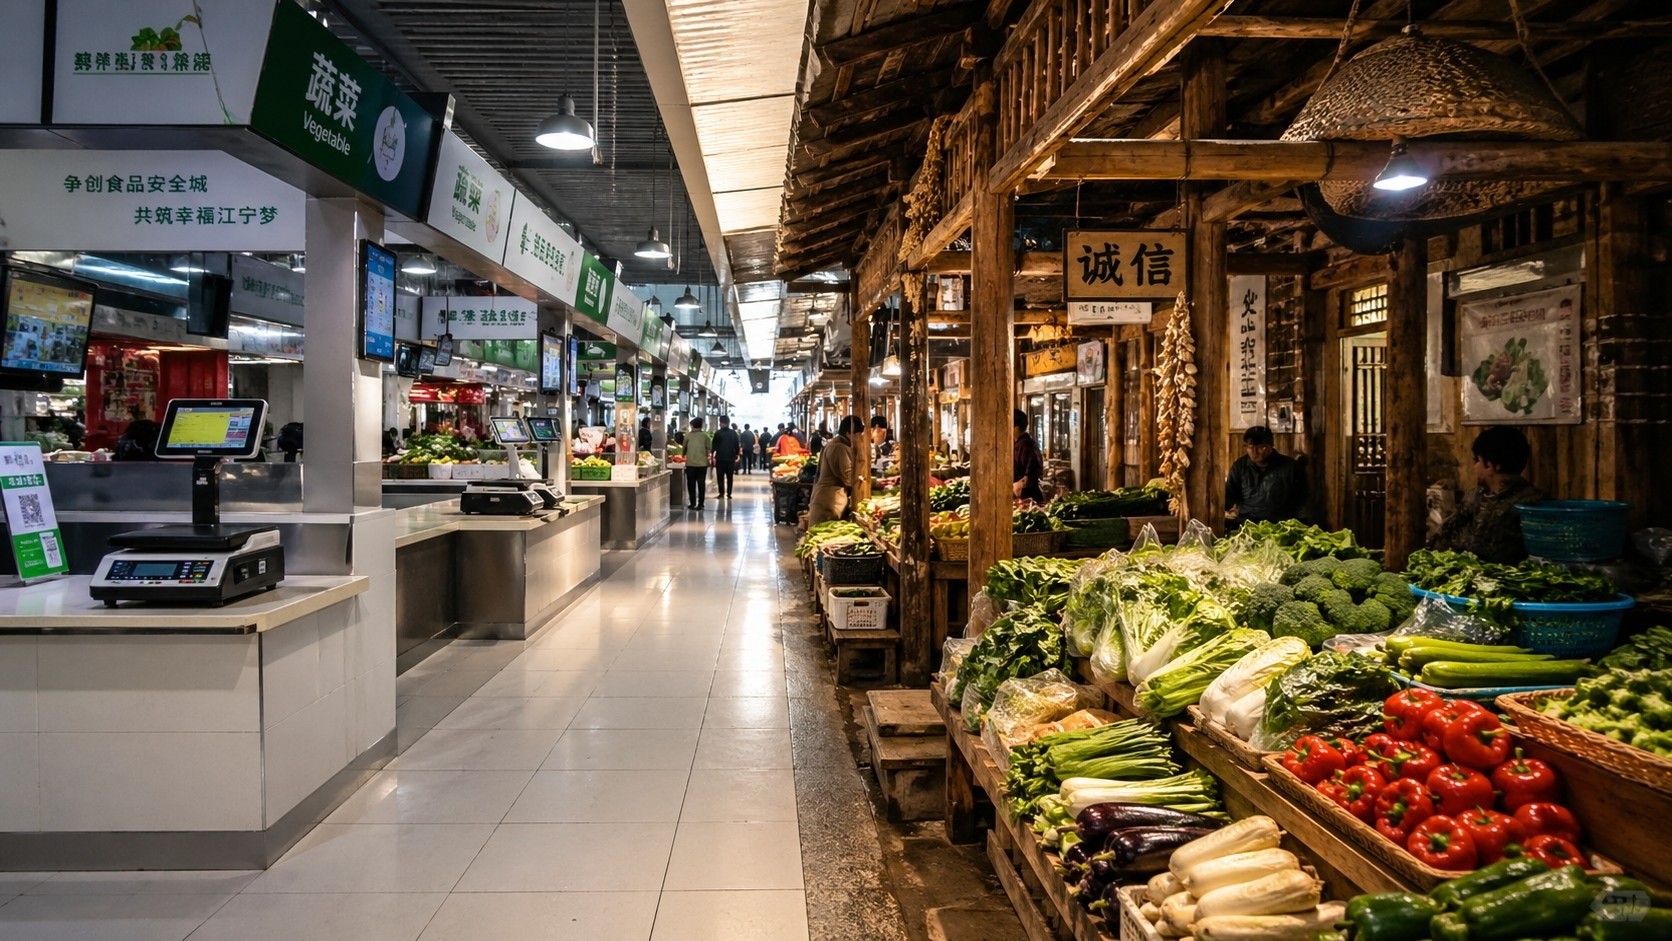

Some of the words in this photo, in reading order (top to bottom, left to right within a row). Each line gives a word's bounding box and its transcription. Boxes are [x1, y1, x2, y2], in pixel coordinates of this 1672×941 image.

[305, 51, 362, 132] 蔬菜
[303, 110, 351, 156] Vegetable
[63, 174, 209, 193] 争创食品安全城
[133, 206, 279, 226] 共筑幸福江宁梦
[1076, 242, 1175, 287] 诚信
